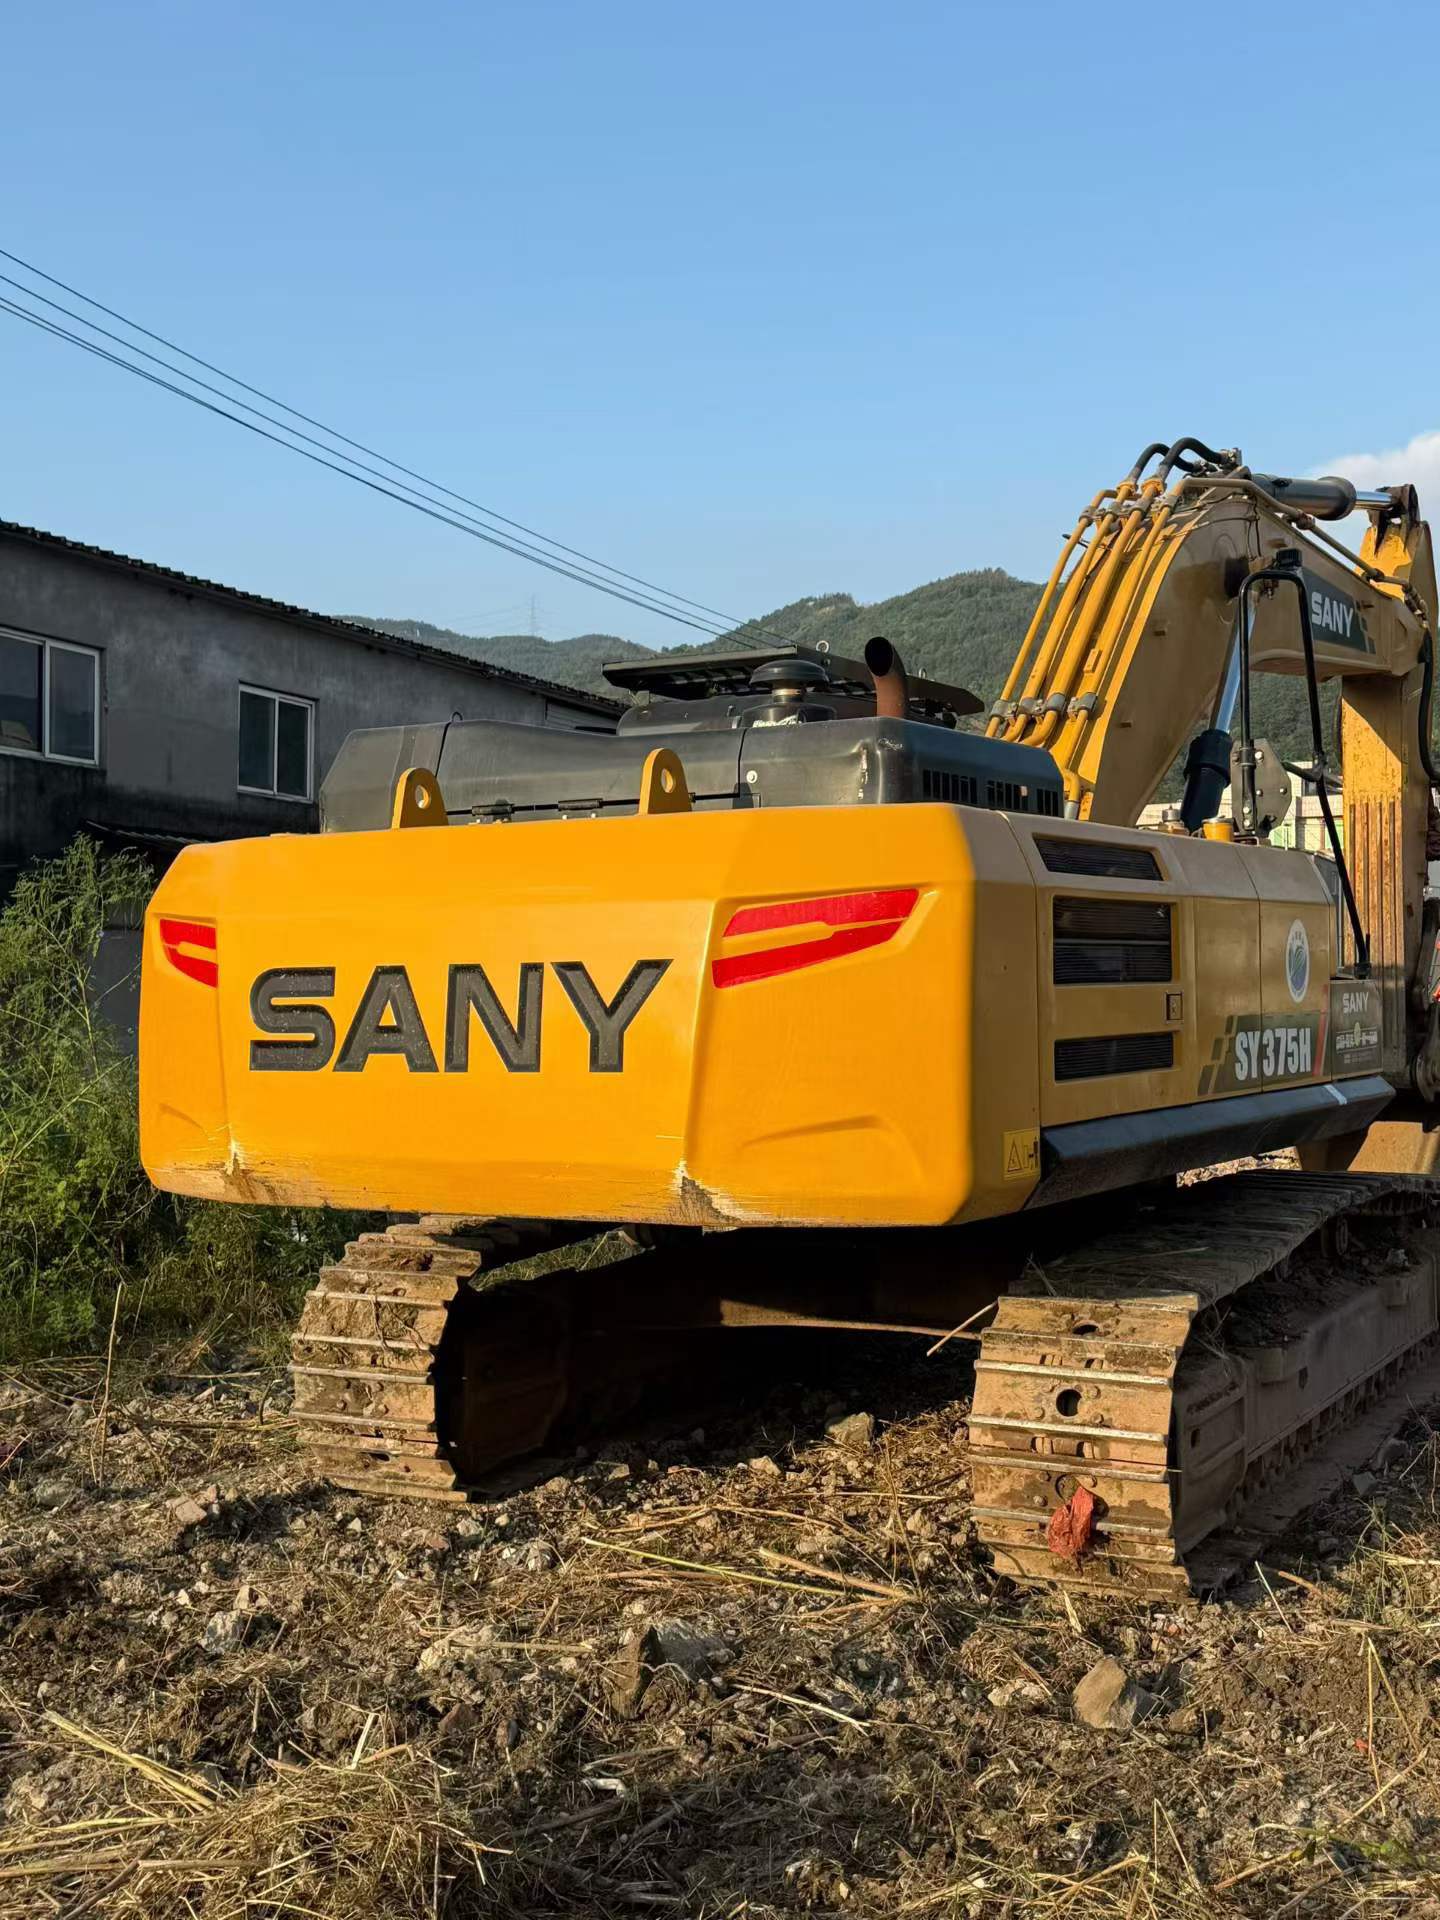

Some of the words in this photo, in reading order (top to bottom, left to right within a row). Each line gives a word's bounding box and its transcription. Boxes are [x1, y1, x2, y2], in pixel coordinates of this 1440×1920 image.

[1311, 591, 1354, 638] SANY
[249, 958, 674, 1073] SANY
[1342, 991, 1369, 1013] SANY
[1235, 1027, 1311, 1081] SY375H
